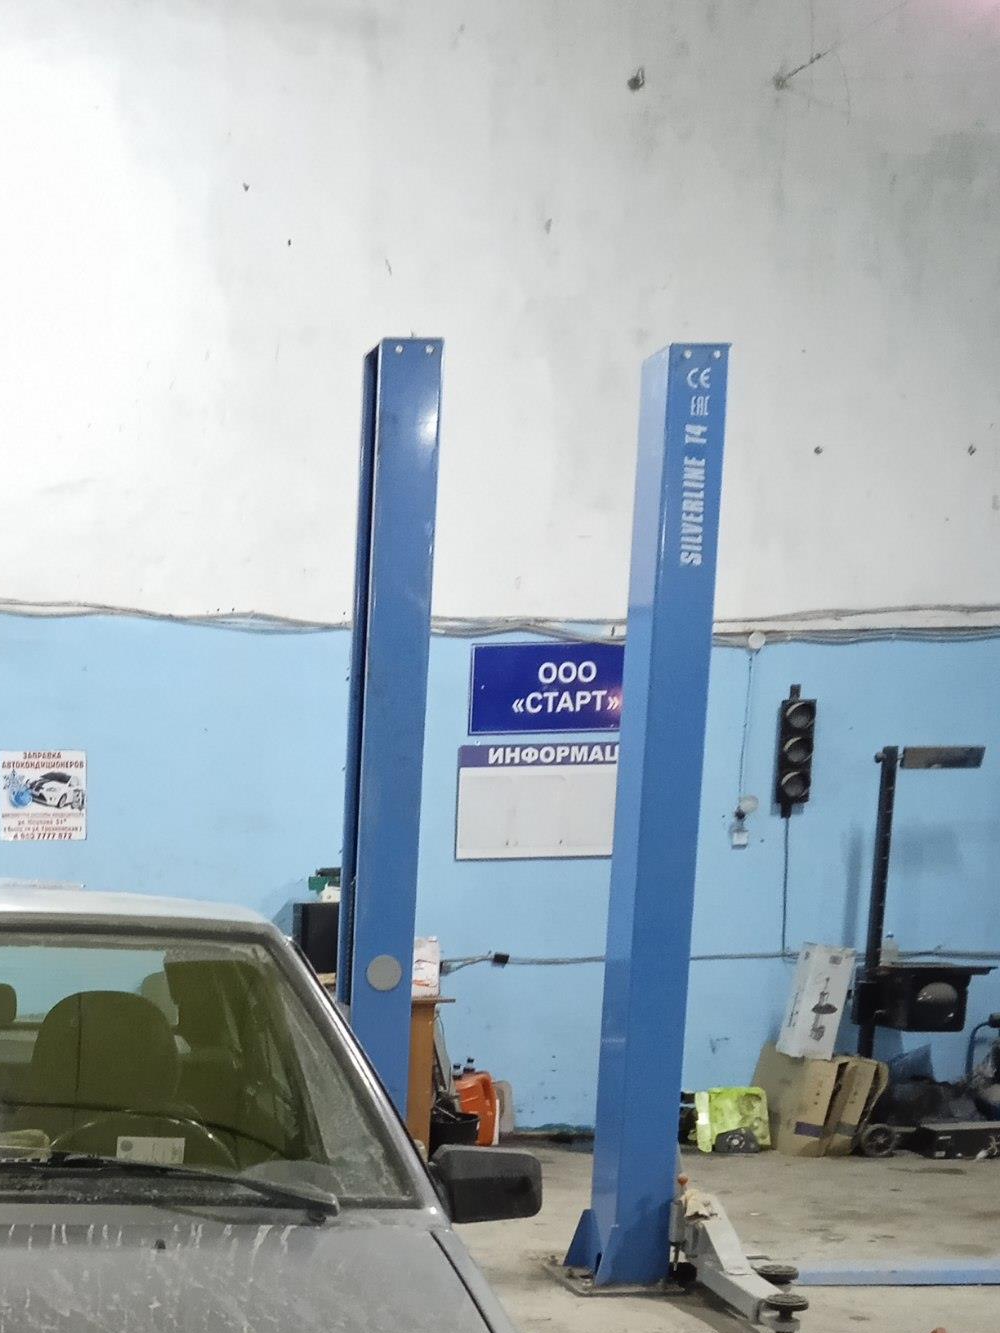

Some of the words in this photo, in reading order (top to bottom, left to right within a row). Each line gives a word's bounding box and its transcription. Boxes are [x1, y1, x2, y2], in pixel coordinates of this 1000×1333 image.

[680, 456, 706, 566] SILVERLINE
[537, 660, 598, 685] ООО
[511, 690, 620, 714] «СТАРТ»
[1, 761, 85, 769] АВТОКОНДИЦИОНЕРОВ
[22, 752, 62, 760] ЗАПРАВКА
[487, 743, 619, 766] ИНФОРМАЦ
